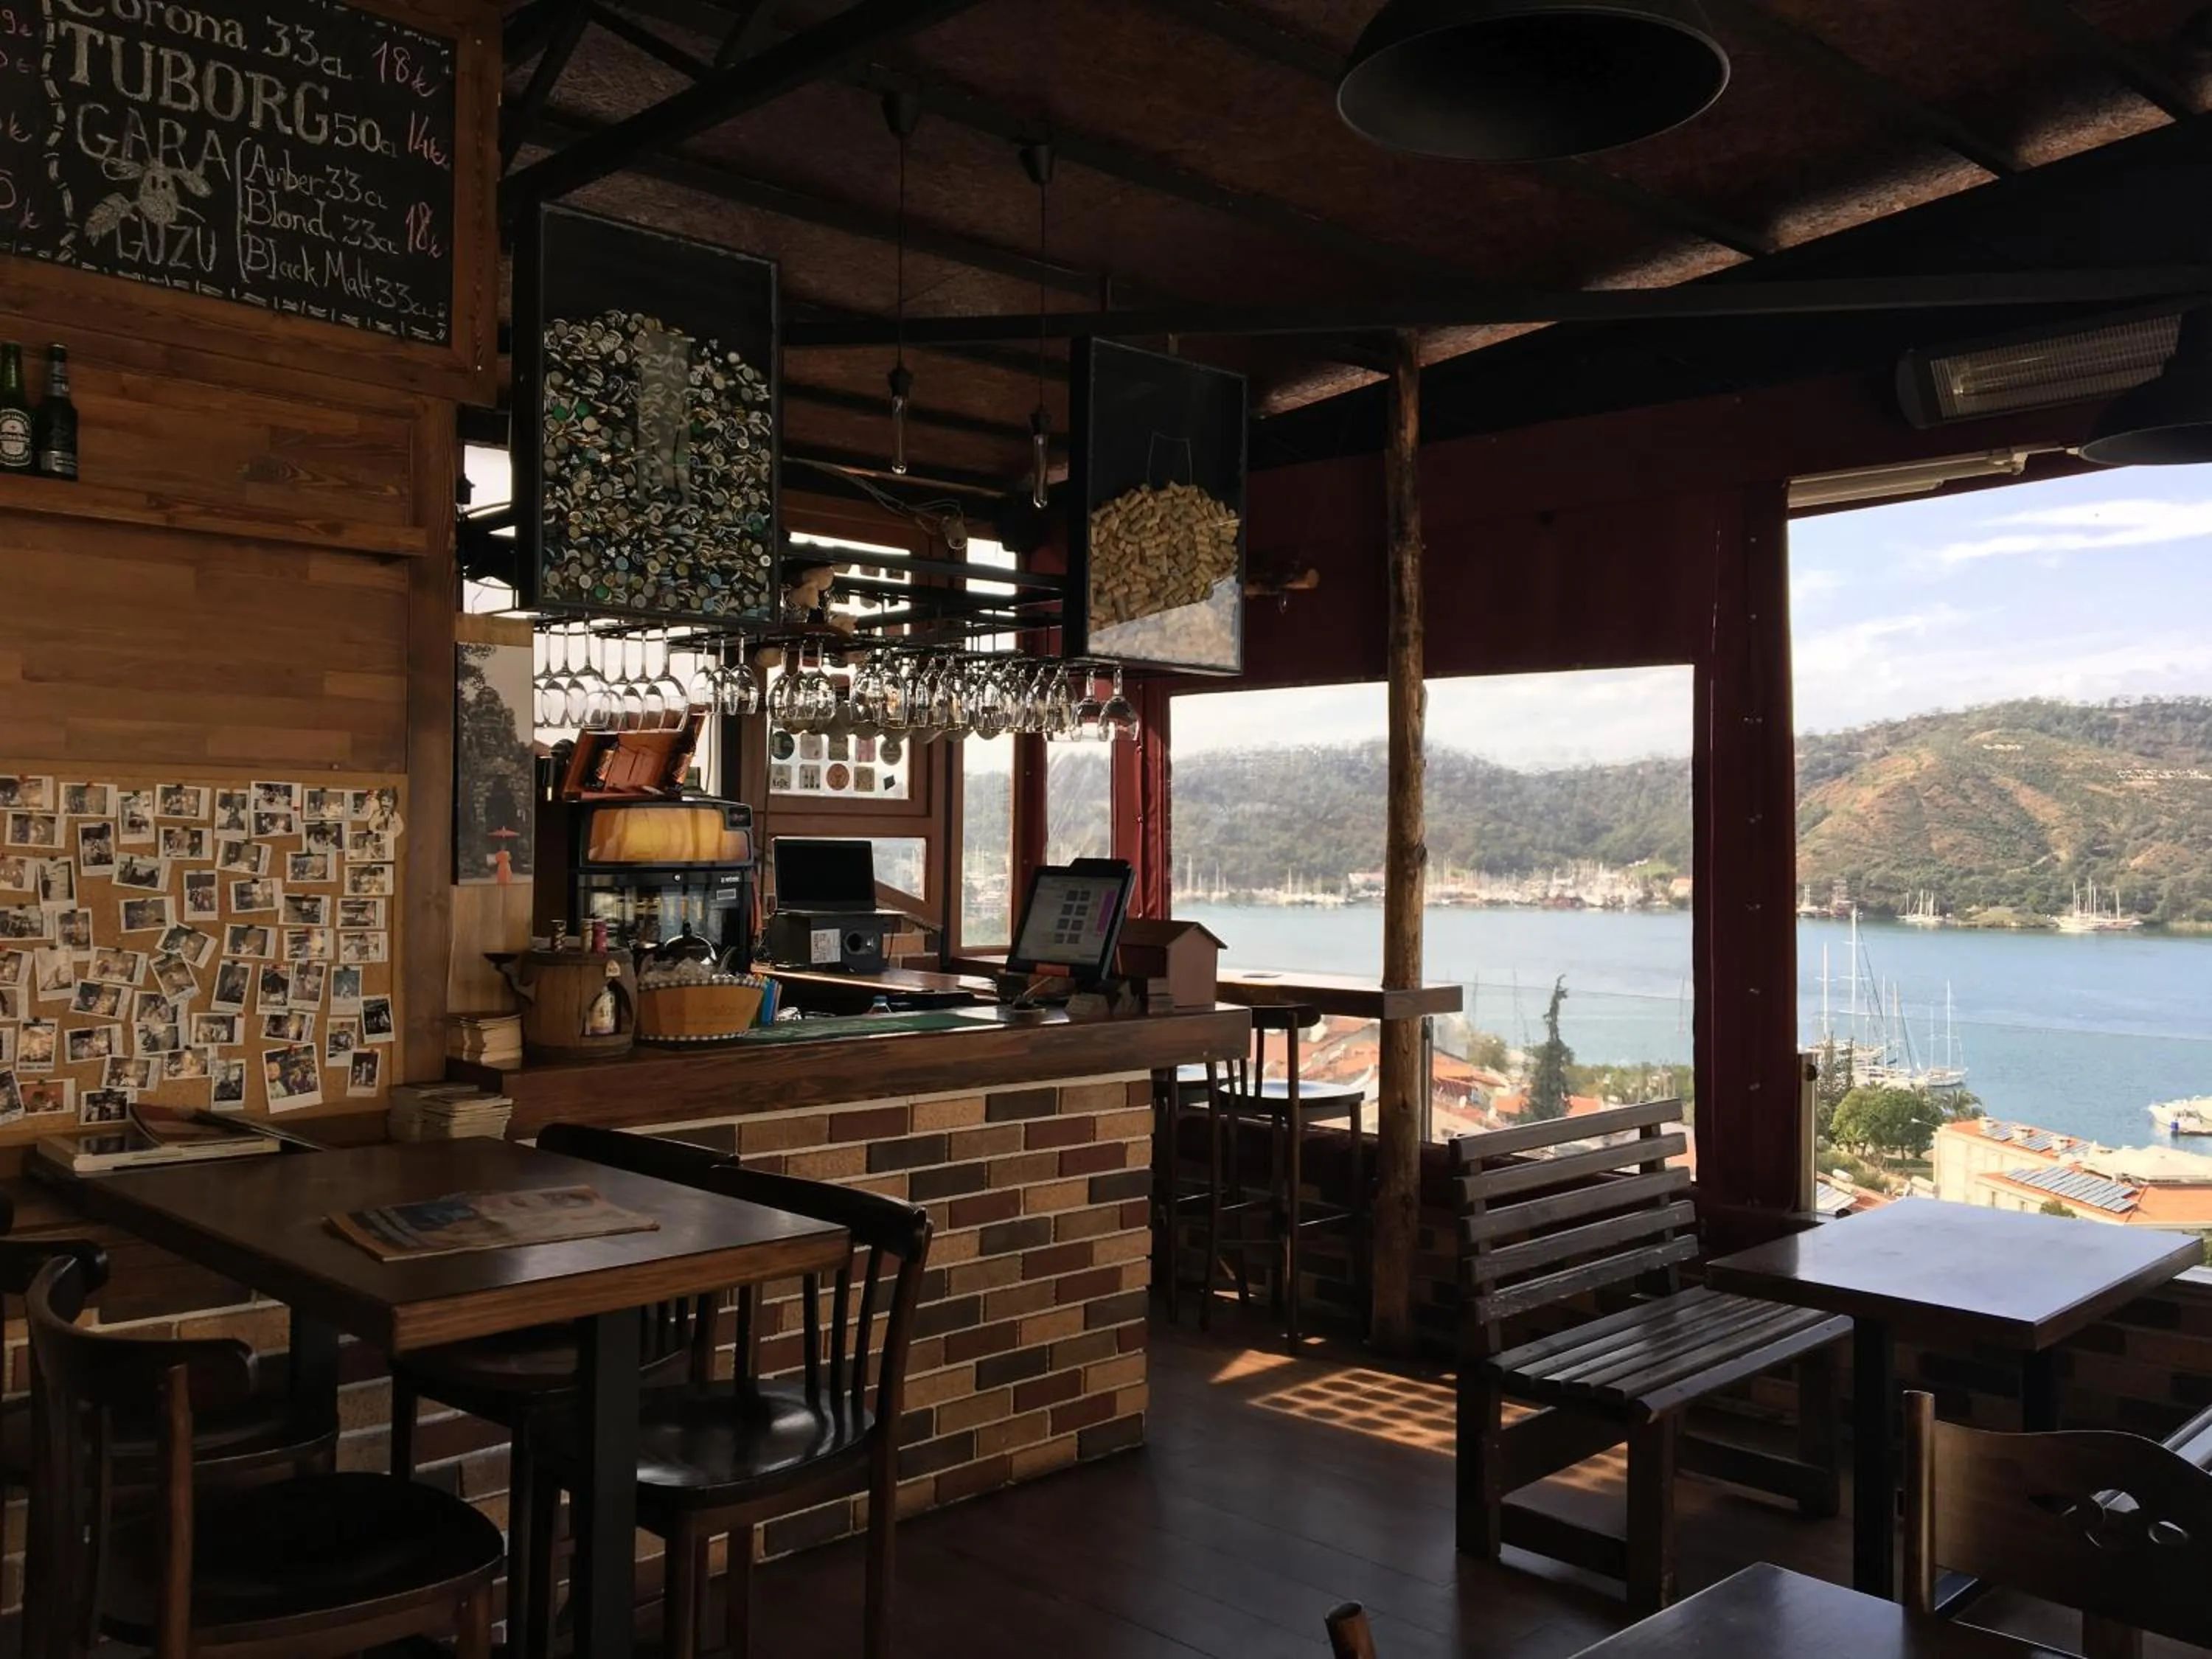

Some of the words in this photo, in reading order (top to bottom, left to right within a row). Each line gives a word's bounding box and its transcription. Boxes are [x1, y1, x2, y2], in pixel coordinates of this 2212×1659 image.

[58, 19, 330, 145] TUBORG
[76, 102, 232, 182] GARA
[114, 214, 218, 272] GUZU
[243, 184, 336, 242] Blond
[243, 230, 319, 288] Black
[324, 249, 372, 299] Malt
